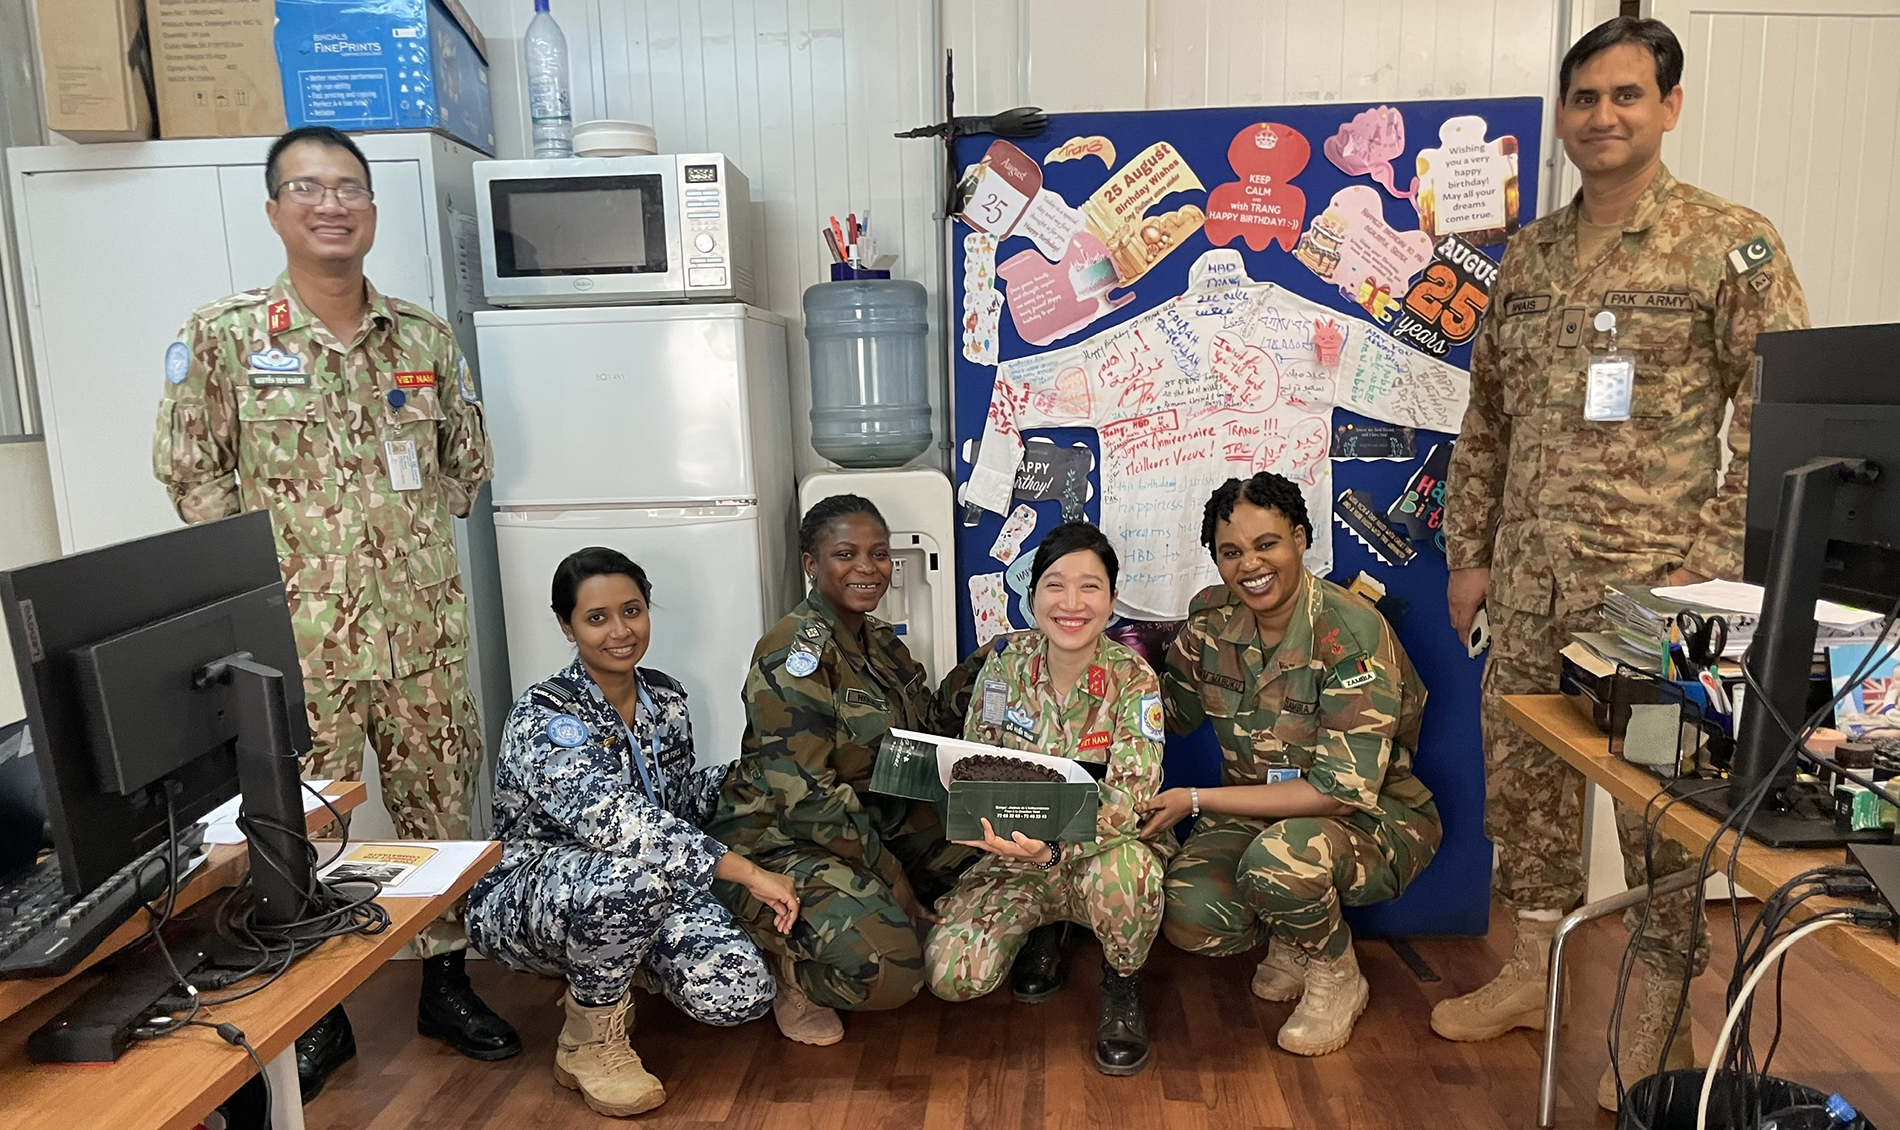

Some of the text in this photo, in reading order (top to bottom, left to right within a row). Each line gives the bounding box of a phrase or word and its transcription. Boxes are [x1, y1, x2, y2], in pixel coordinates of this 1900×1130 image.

[1058, 140, 1103, 157] Trang
[1449, 145, 1485, 155] Wishing
[1445, 159, 1462, 168] you
[1470, 156, 1490, 165] very
[1000, 158, 1027, 181] August
[1104, 143, 1171, 204] 25 August
[1454, 168, 1482, 177] happy
[1249, 174, 1271, 184] KEEP
[1448, 177, 1489, 189] birthday!
[1115, 159, 1179, 215] Birthday Wishes
[1245, 185, 1271, 196] CALM
[1442, 188, 1496, 201] May all your
[981, 193, 1008, 223] 25
[1231, 201, 1281, 215] wish TRANG
[1453, 201, 1486, 211] dreams
[1209, 211, 1238, 222] HAPPY
[1240, 214, 1286, 228] BIRTHDAY!
[1445, 212, 1494, 223] come true.
[1023, 221, 1039, 238] Happy
[1162, 303, 1177, 312] USA
[1406, 264, 1489, 340] 25
[1611, 294, 1687, 308] PAK ARMY
[1393, 316, 1446, 354] years
[1391, 344, 1413, 356] YOU
[397, 375, 433, 384] VIET NAM
[1122, 439, 1148, 459] Joyeux
[1152, 427, 1217, 450] Anniversaire
[1223, 420, 1260, 436] TRANG
[1018, 460, 1050, 475] APPY
[1126, 457, 1169, 476] Meilleurs
[1124, 548, 1155, 565] HBD
[1346, 673, 1374, 687] ZAMBIA
[533, 689, 563, 708] BANGLADESH
[1285, 700, 1310, 714] ZAMBIA
[1093, 736, 1109, 745] NAM
[661, 753, 670, 762] AIR
